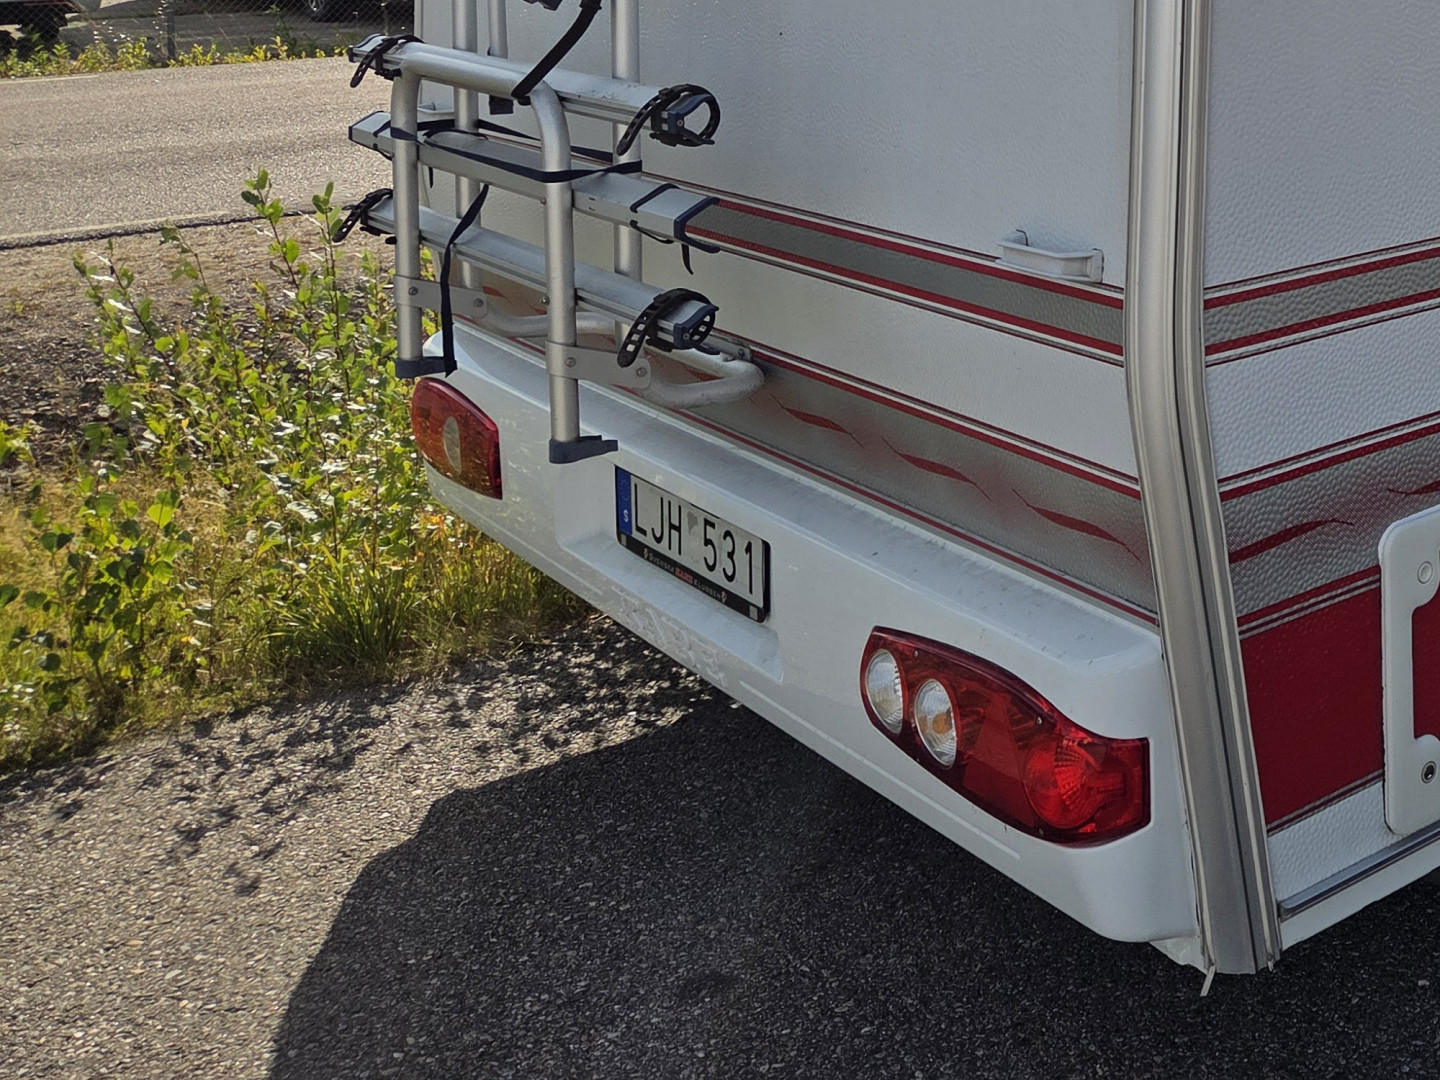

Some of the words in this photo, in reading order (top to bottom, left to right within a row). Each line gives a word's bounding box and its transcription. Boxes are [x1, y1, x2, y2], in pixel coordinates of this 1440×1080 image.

[623, 509, 629, 523] S
[634, 483, 681, 555] LJH
[703, 517, 752, 595] 531
